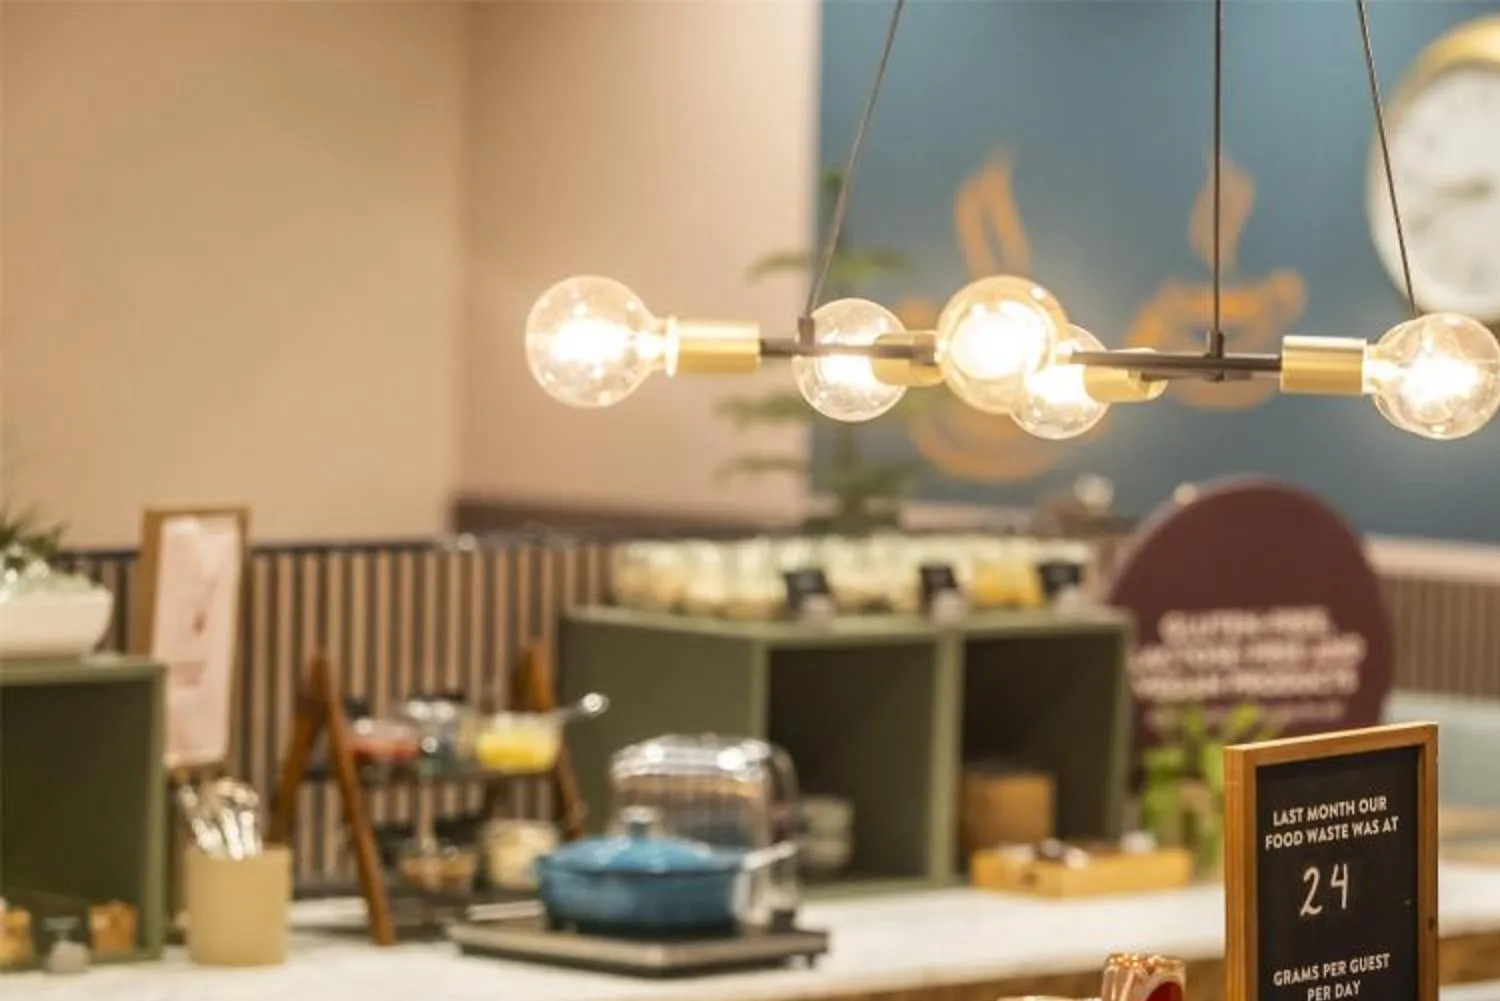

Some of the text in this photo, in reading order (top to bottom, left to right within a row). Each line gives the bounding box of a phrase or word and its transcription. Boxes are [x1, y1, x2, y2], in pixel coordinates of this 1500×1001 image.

[1273, 795, 1388, 827] LAST MONTH OUR
[1265, 815, 1399, 851] FOOD WASTE WAS AT
[1300, 863, 1349, 917] 24
[1273, 952, 1391, 987] GRAMS PER GUEST
[1335, 979, 1361, 999] DAY
